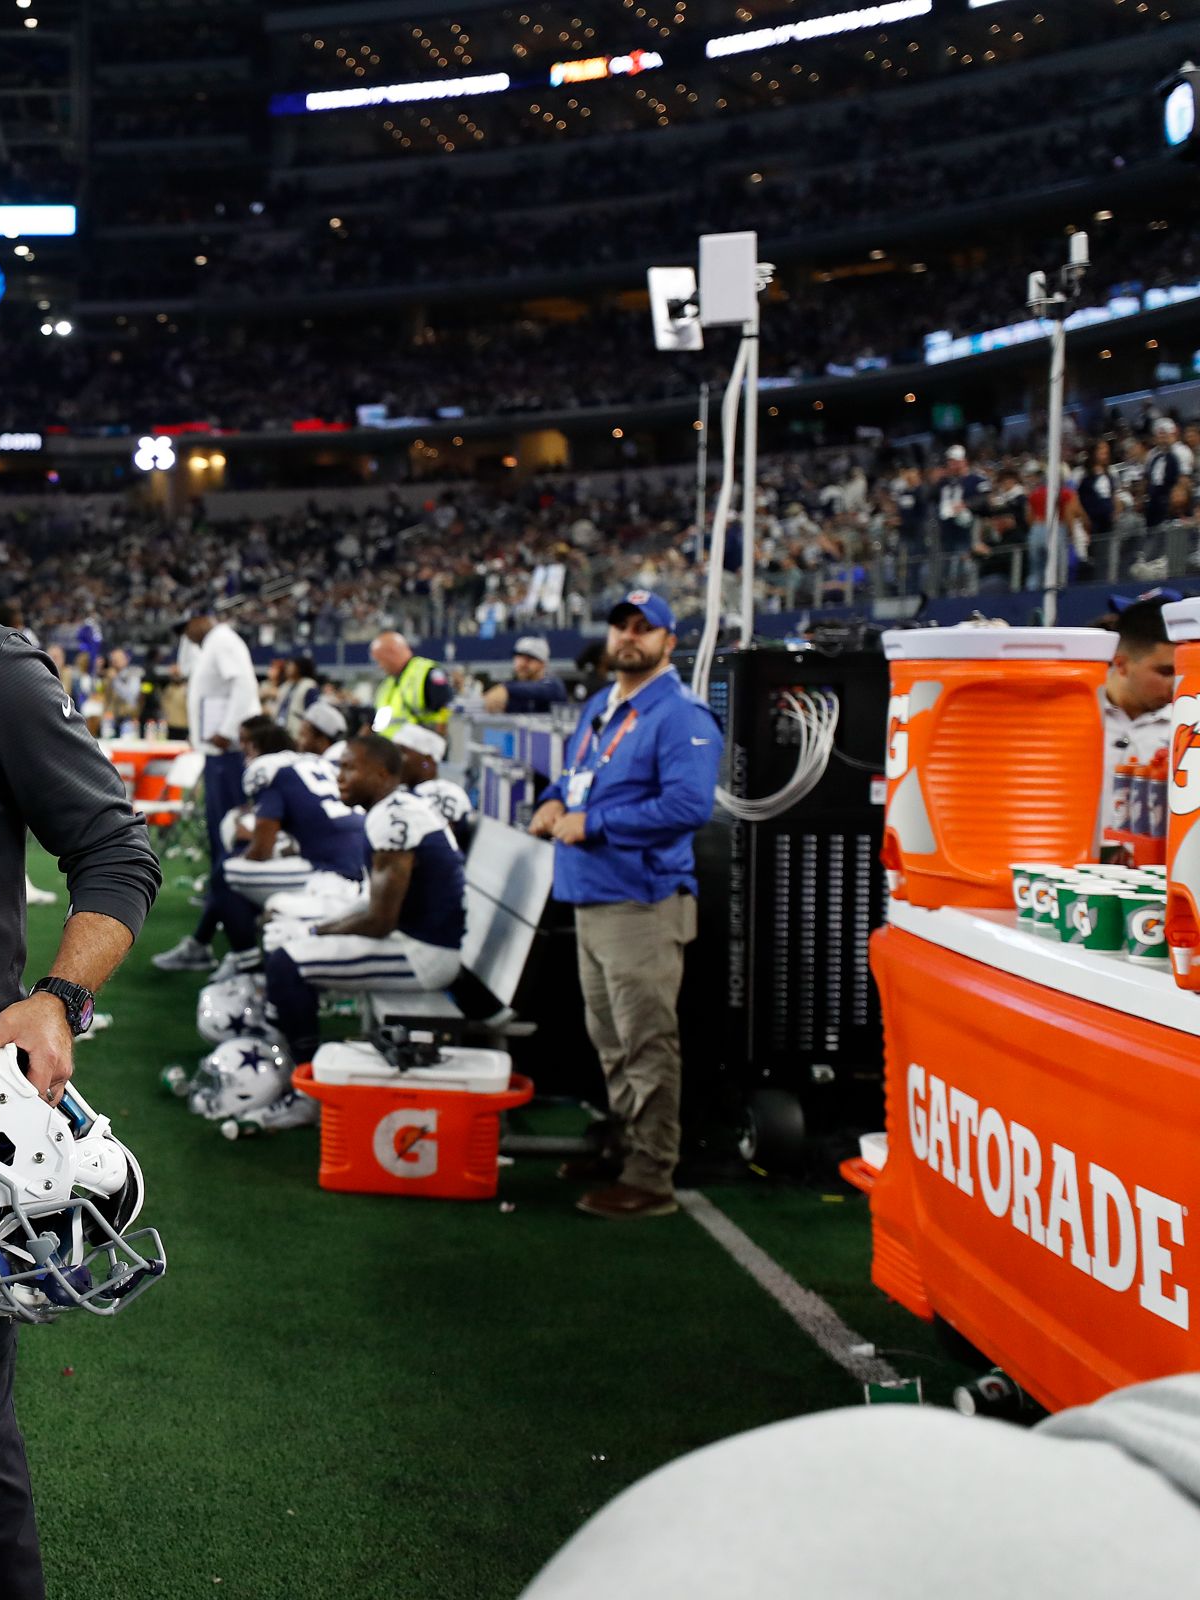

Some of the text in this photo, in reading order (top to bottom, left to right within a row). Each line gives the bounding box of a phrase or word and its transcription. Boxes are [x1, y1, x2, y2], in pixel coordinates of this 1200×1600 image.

[389, 820, 408, 849] 3
[1013, 877, 1033, 909] G
[1030, 881, 1052, 914] G
[1131, 910, 1166, 946] G
[729, 940, 745, 1008] HOME
[373, 1108, 438, 1178] G
[907, 1063, 1189, 1331] GATORADE
